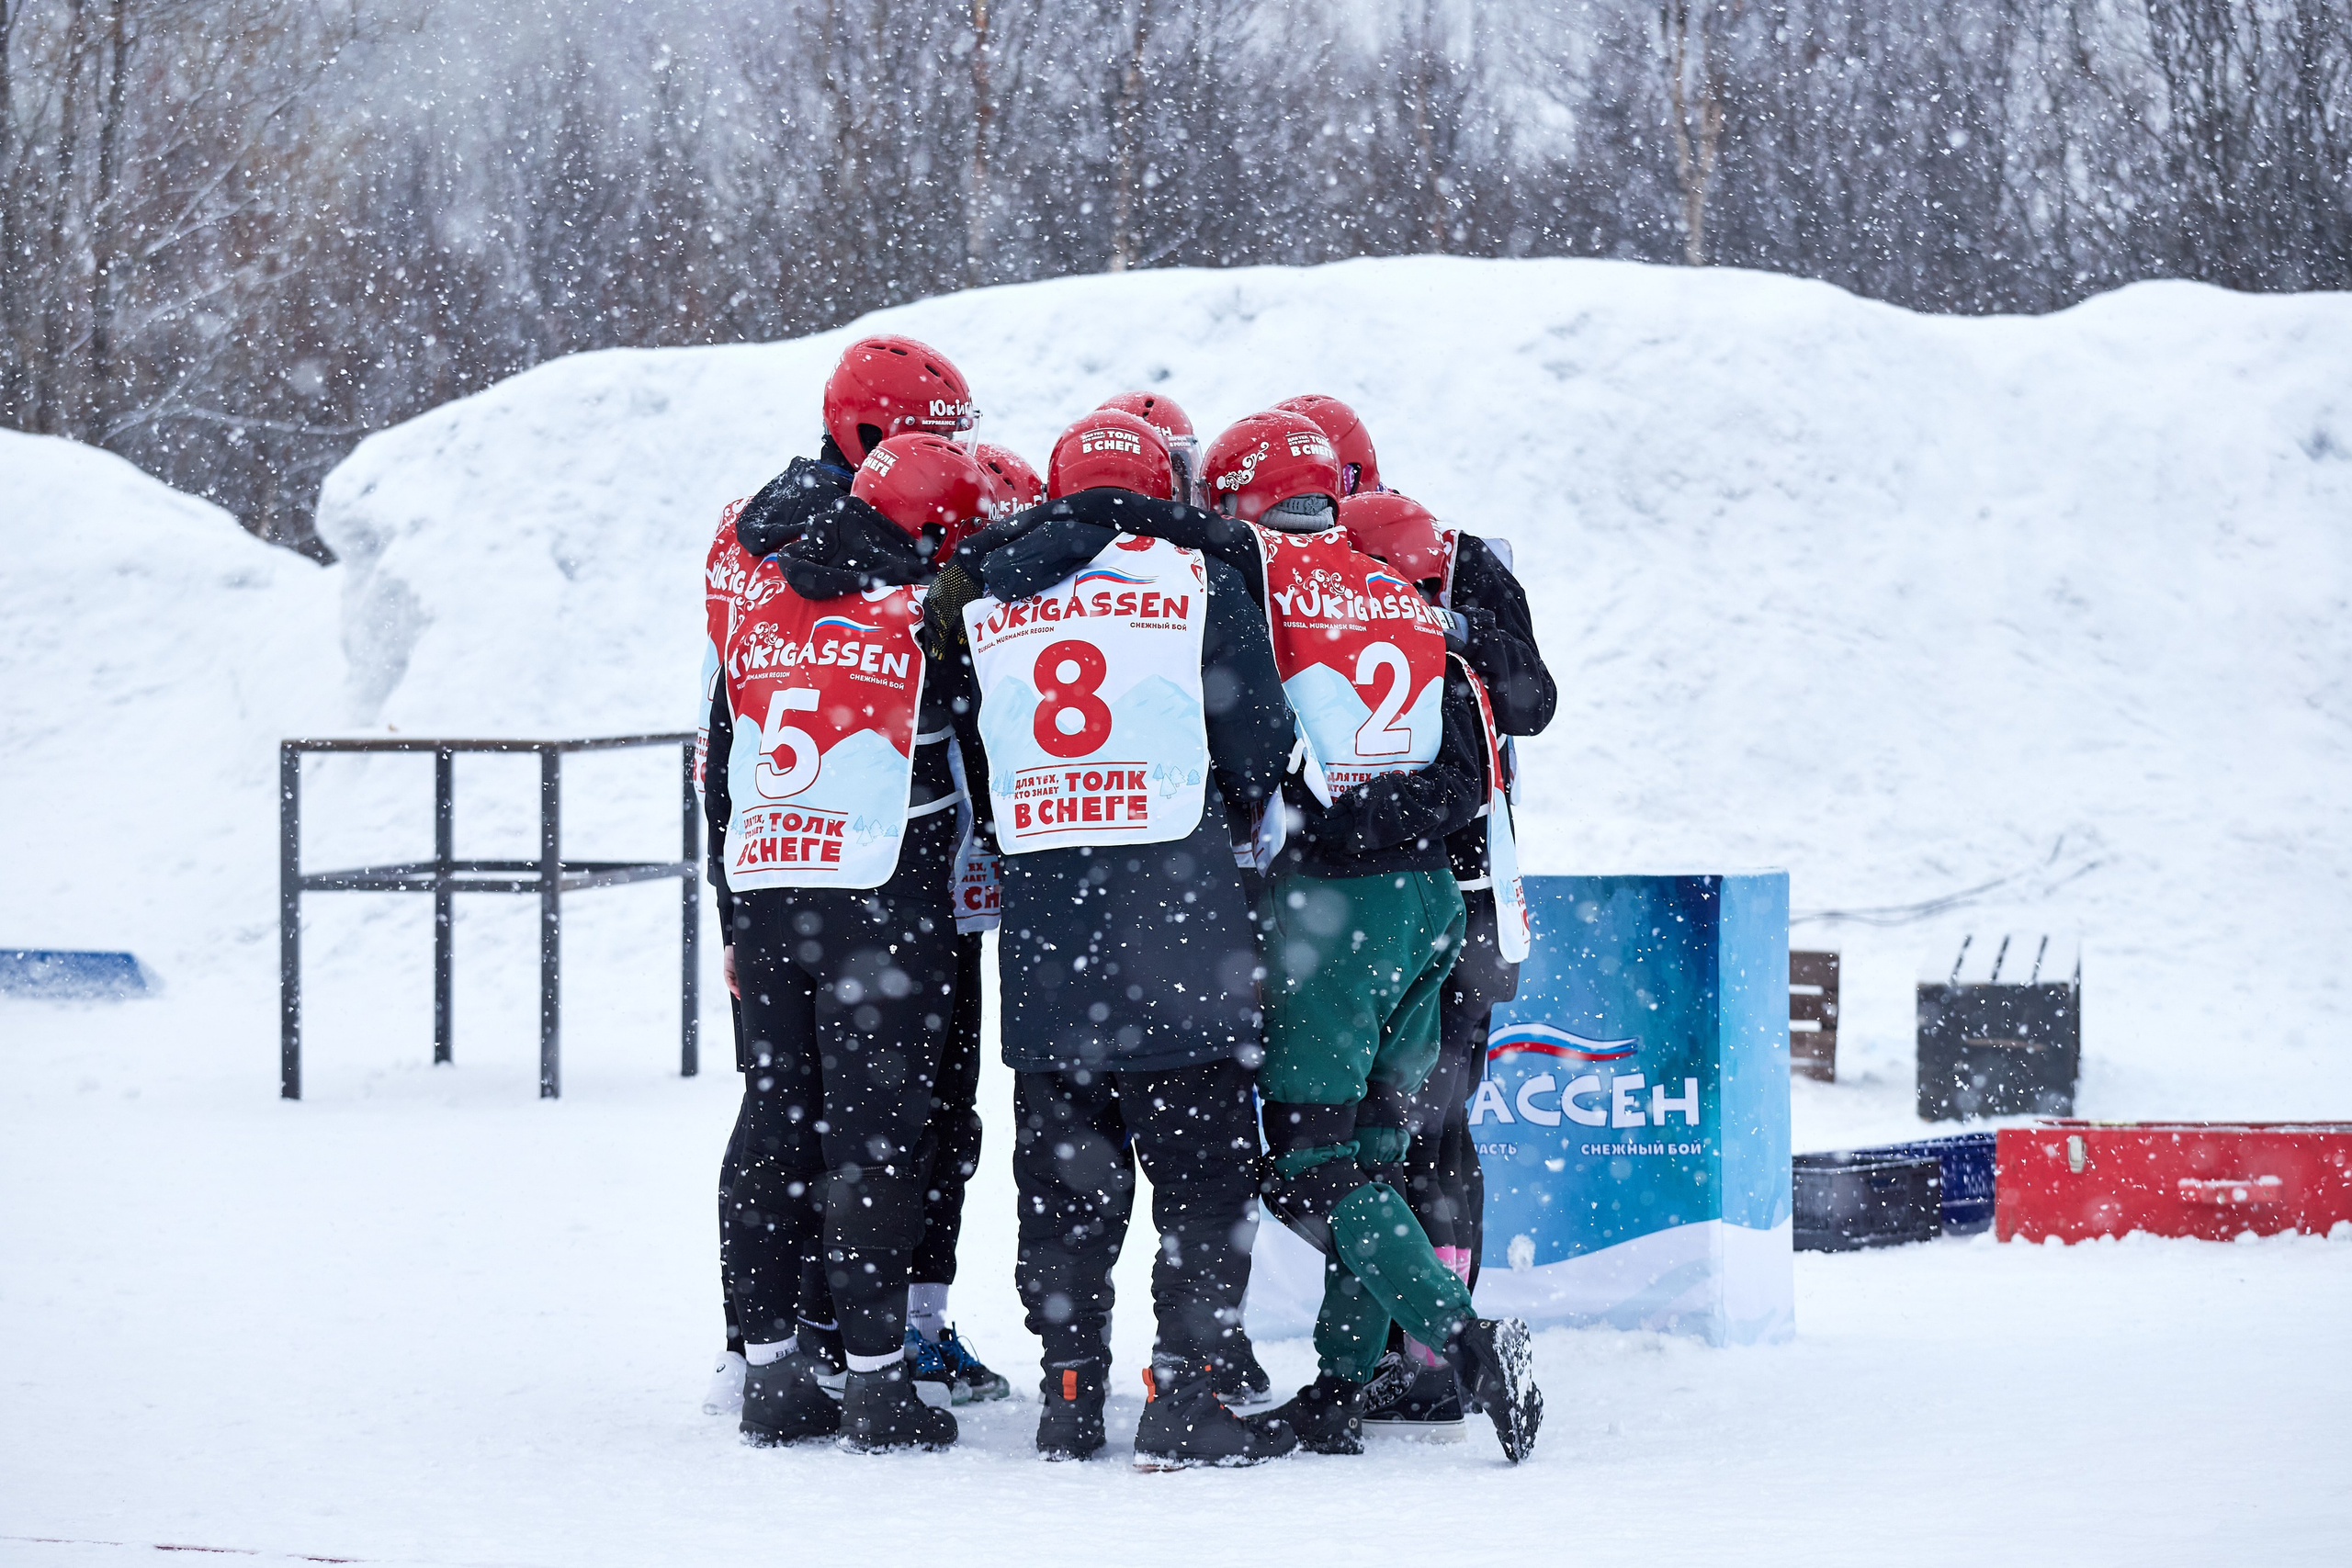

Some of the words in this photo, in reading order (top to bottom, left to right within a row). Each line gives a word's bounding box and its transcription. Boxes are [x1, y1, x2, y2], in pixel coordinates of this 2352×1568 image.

[1107, 431, 1139, 443] ТОЛК
[1082, 443, 1092, 454] В
[1094, 440, 1141, 455] СНЕГЕ
[1290, 446, 1301, 457] В
[1171, 624, 1187, 632] БОЙ
[996, 629, 1029, 644] MURMANSK
[850, 673, 888, 686] СНЕЖНЫЙ
[889, 681, 905, 690] БОЙ
[1033, 639, 1112, 758] 8
[1355, 641, 1411, 756] 2
[755, 687, 820, 799] 5
[1015, 777, 1035, 790] ДЛЯ
[1036, 774, 1059, 785] ТЕХ,
[1065, 771, 1148, 792] ТОЛК
[1327, 773, 1350, 783] ДЛЯ
[1014, 790, 1030, 799] КТО
[1032, 786, 1059, 797] ЗНАЕТ
[1014, 803, 1032, 829] В
[1038, 795, 1148, 825] СНЕГЕ
[769, 812, 846, 838] ТОЛК
[736, 843, 750, 866] В
[747, 837, 842, 864] СНЕГЕ
[1580, 1140, 1664, 1156] СНЕЖНЫЙ
[1668, 1140, 1702, 1156] БОЙ
